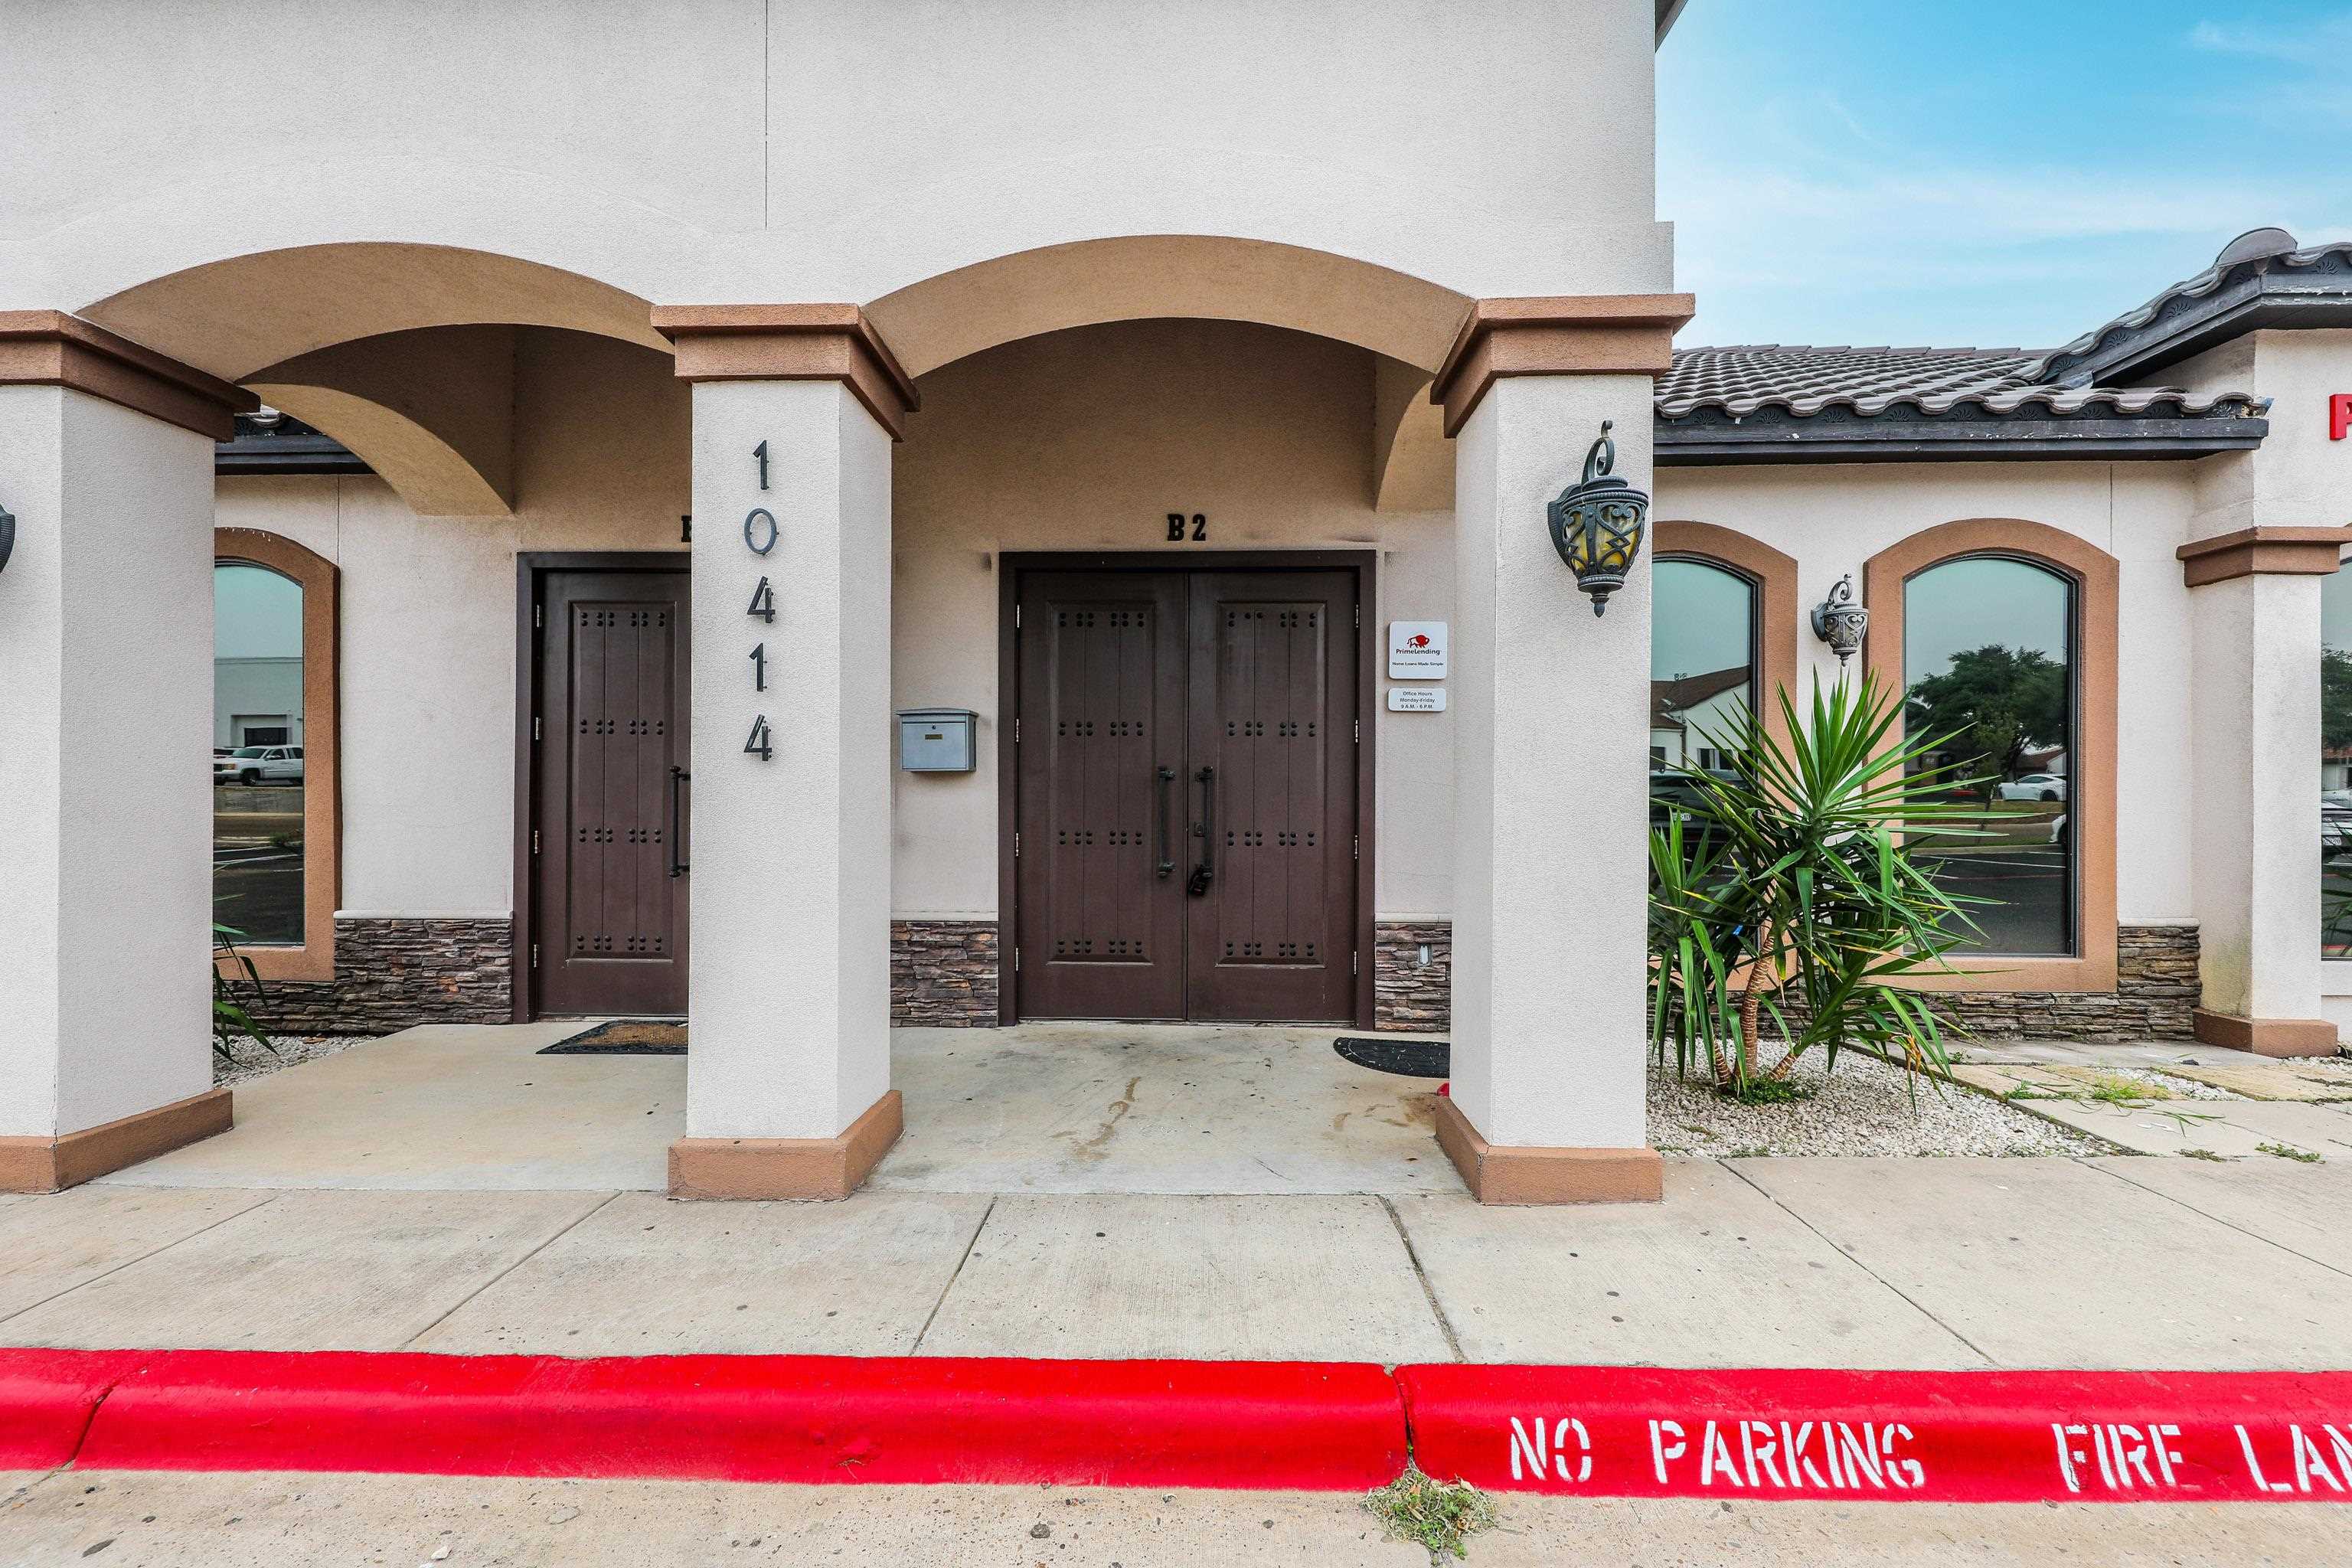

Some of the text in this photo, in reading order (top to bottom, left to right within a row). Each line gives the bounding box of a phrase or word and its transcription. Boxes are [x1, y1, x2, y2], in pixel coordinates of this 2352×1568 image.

[743, 439, 778, 762] 10414
[1511, 1416, 1592, 1482] NO
[1648, 1419, 1925, 1489] PARKING
[2051, 1423, 2203, 1494] FIRE
